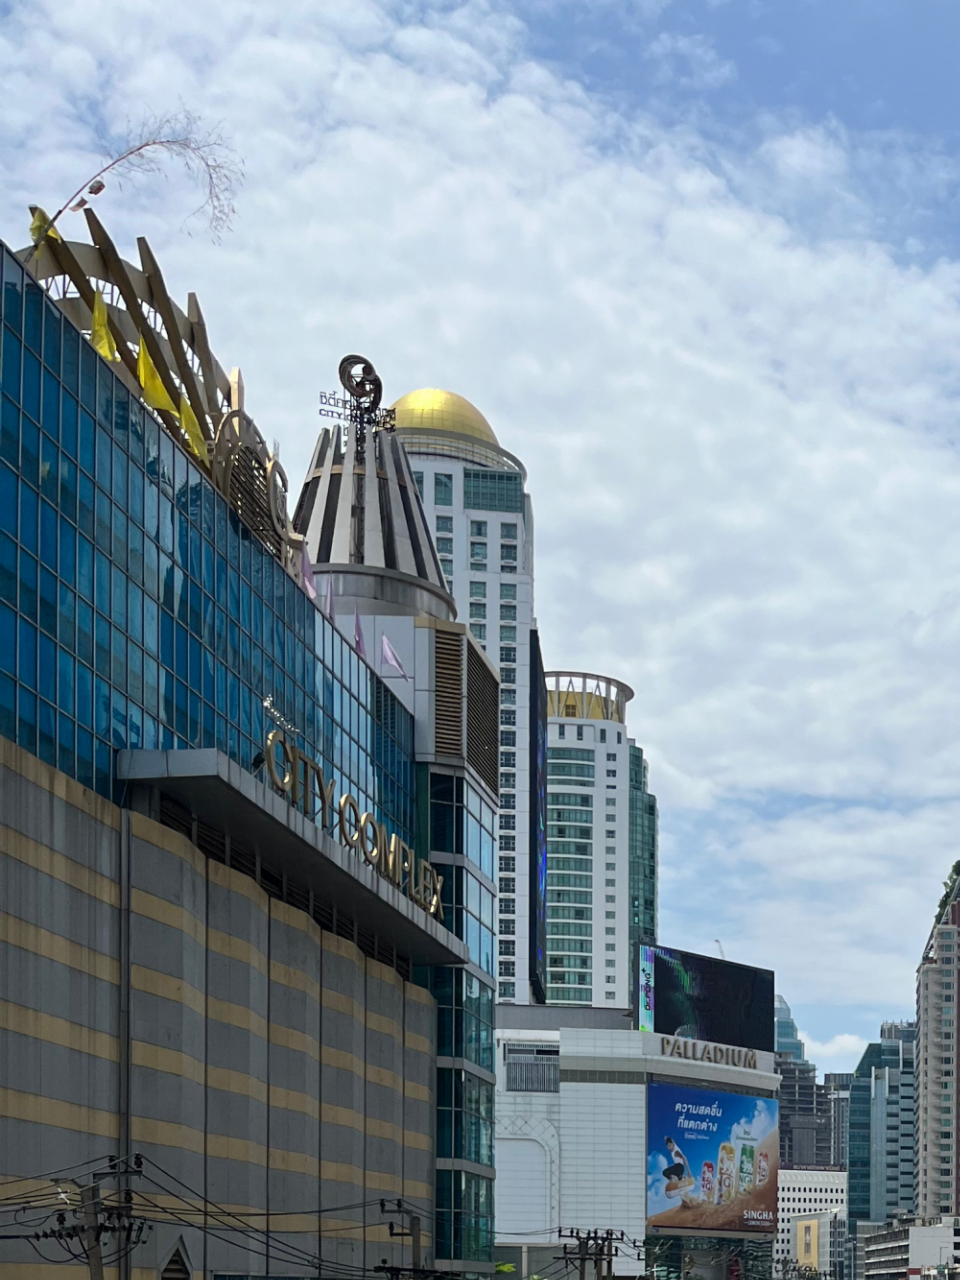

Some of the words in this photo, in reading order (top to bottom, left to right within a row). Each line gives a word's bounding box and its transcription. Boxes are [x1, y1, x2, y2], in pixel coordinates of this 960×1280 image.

[318, 407, 343, 419] CITY
[266, 729, 337, 829] CITY
[339, 793, 444, 922] COMPLEX
[660, 1036, 758, 1070] PALLADIUM
[674, 1101, 723, 1118] ความสดชื่น
[676, 1113, 719, 1133] ที่แตกต่าง
[743, 1209, 774, 1220] SINGHA
